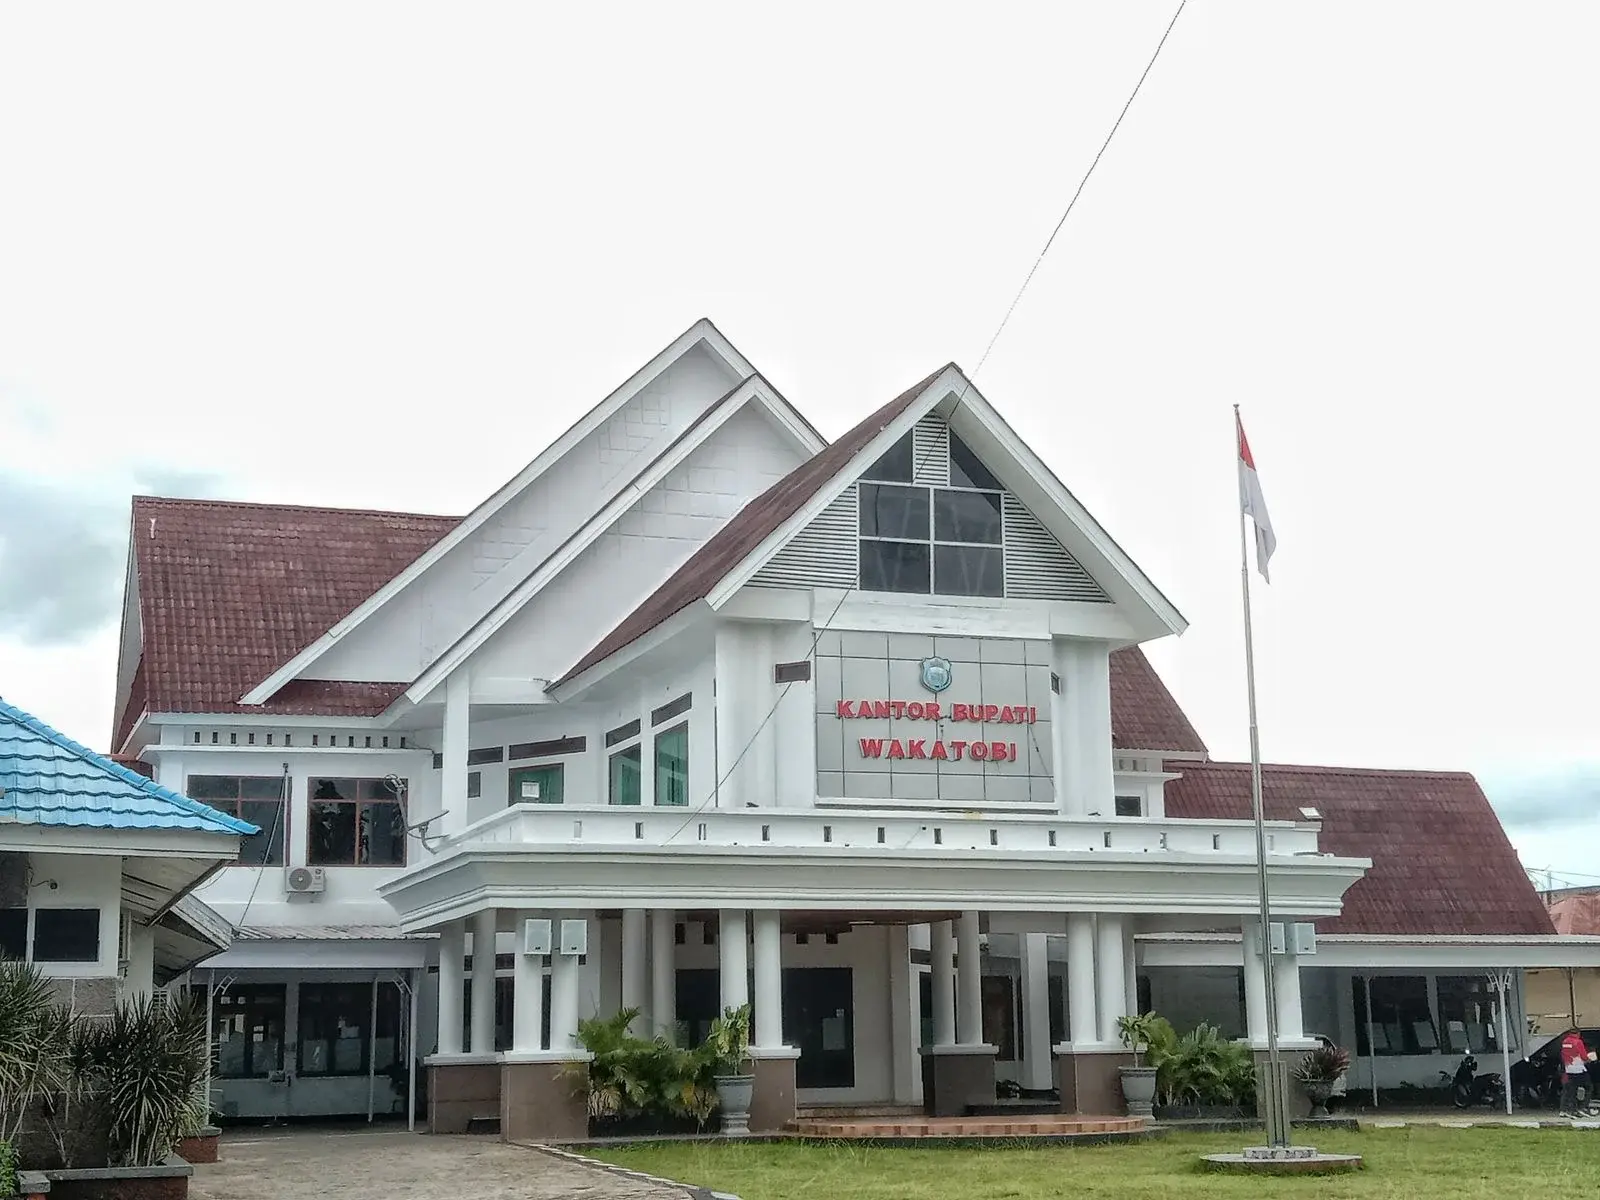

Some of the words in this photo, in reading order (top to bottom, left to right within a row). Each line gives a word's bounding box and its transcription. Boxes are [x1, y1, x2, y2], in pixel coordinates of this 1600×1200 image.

[836, 700, 941, 721] KANTOR
[951, 703, 1037, 724] BUPATI
[859, 738, 1017, 762] WAKATOBI
